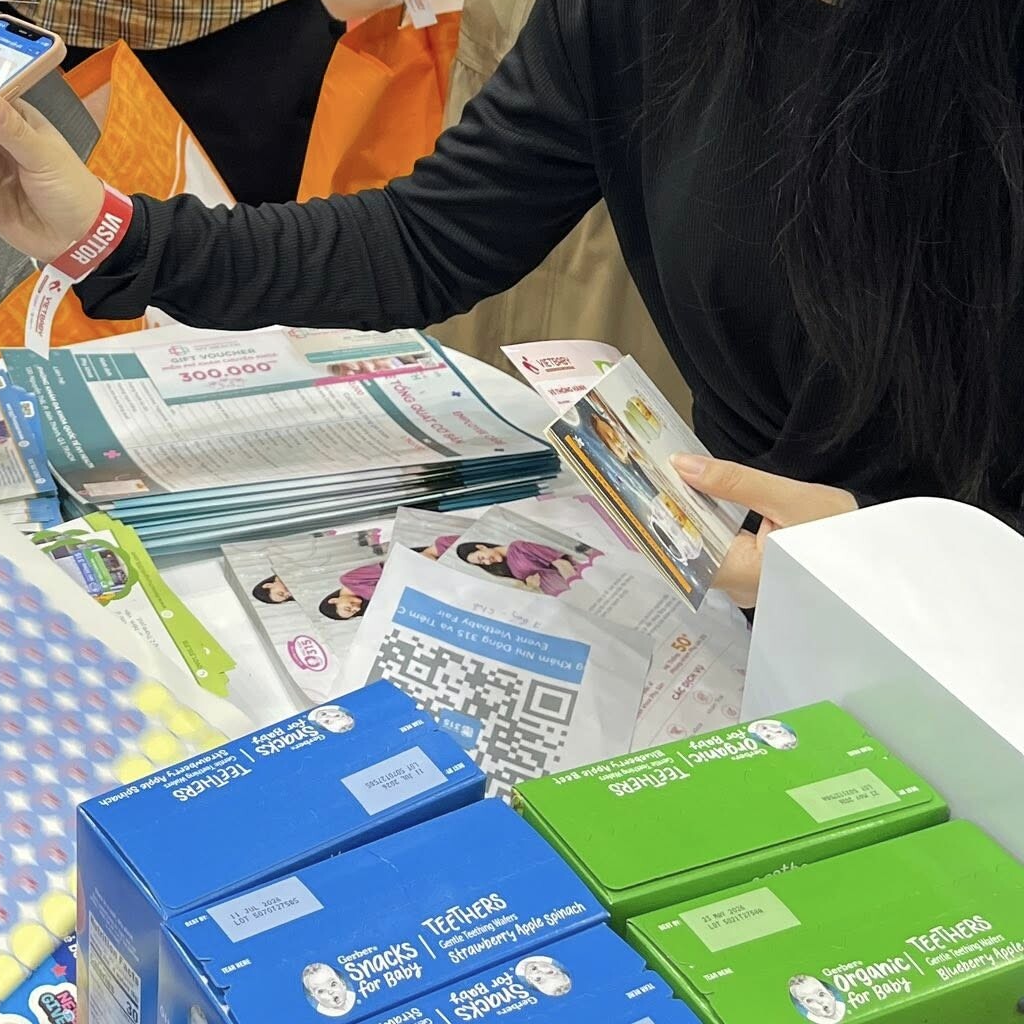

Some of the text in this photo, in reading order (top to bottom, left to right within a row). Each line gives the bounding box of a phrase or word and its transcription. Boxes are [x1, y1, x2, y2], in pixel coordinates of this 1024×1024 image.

[70, 212, 123, 265] VISITOR
[170, 347, 256, 363] GIFT VOUCHER
[178, 362, 271, 383] 300.000
[406, 609, 438, 627] Tiêm
[435, 609, 459, 623] Fair
[460, 615, 513, 640] Vietbaby
[456, 628, 478, 641] 315
[515, 633, 549, 651] Event
[515, 646, 535, 659] Nhi
[537, 653, 572, 671] Khám
[251, 719, 307, 744] for Baby
[688, 730, 747, 750] for Baby
[688, 737, 759, 763] Organic
[99, 749, 229, 806] Strawberry Apple Spinach
[552, 749, 666, 785] Blueberry Apple Beet
[173, 764, 253, 801] TEETHERS
[608, 765, 691, 797] TEETHERS
[230, 912, 241, 920] 11
[244, 906, 258, 914] JUL
[234, 917, 249, 926] LOT
[421, 892, 507, 935] TEETHERS
[439, 913, 518, 949] Gentle Teething Wafers
[708, 921, 723, 931] LOT
[905, 914, 992, 953] TEETHERS
[448, 929, 518, 964] Strawberry
[515, 917, 544, 936] Apple
[926, 934, 1005, 967] Gentle Teething Wafers
[337, 946, 378, 964] Gerber
[935, 942, 1023, 982] Blueberry Apple
[358, 962, 422, 998] for Baby
[822, 960, 863, 977] Gerber
[833, 957, 911, 993] Organic
[448, 972, 514, 1005] for Baby
[847, 977, 912, 1009] for Baby
